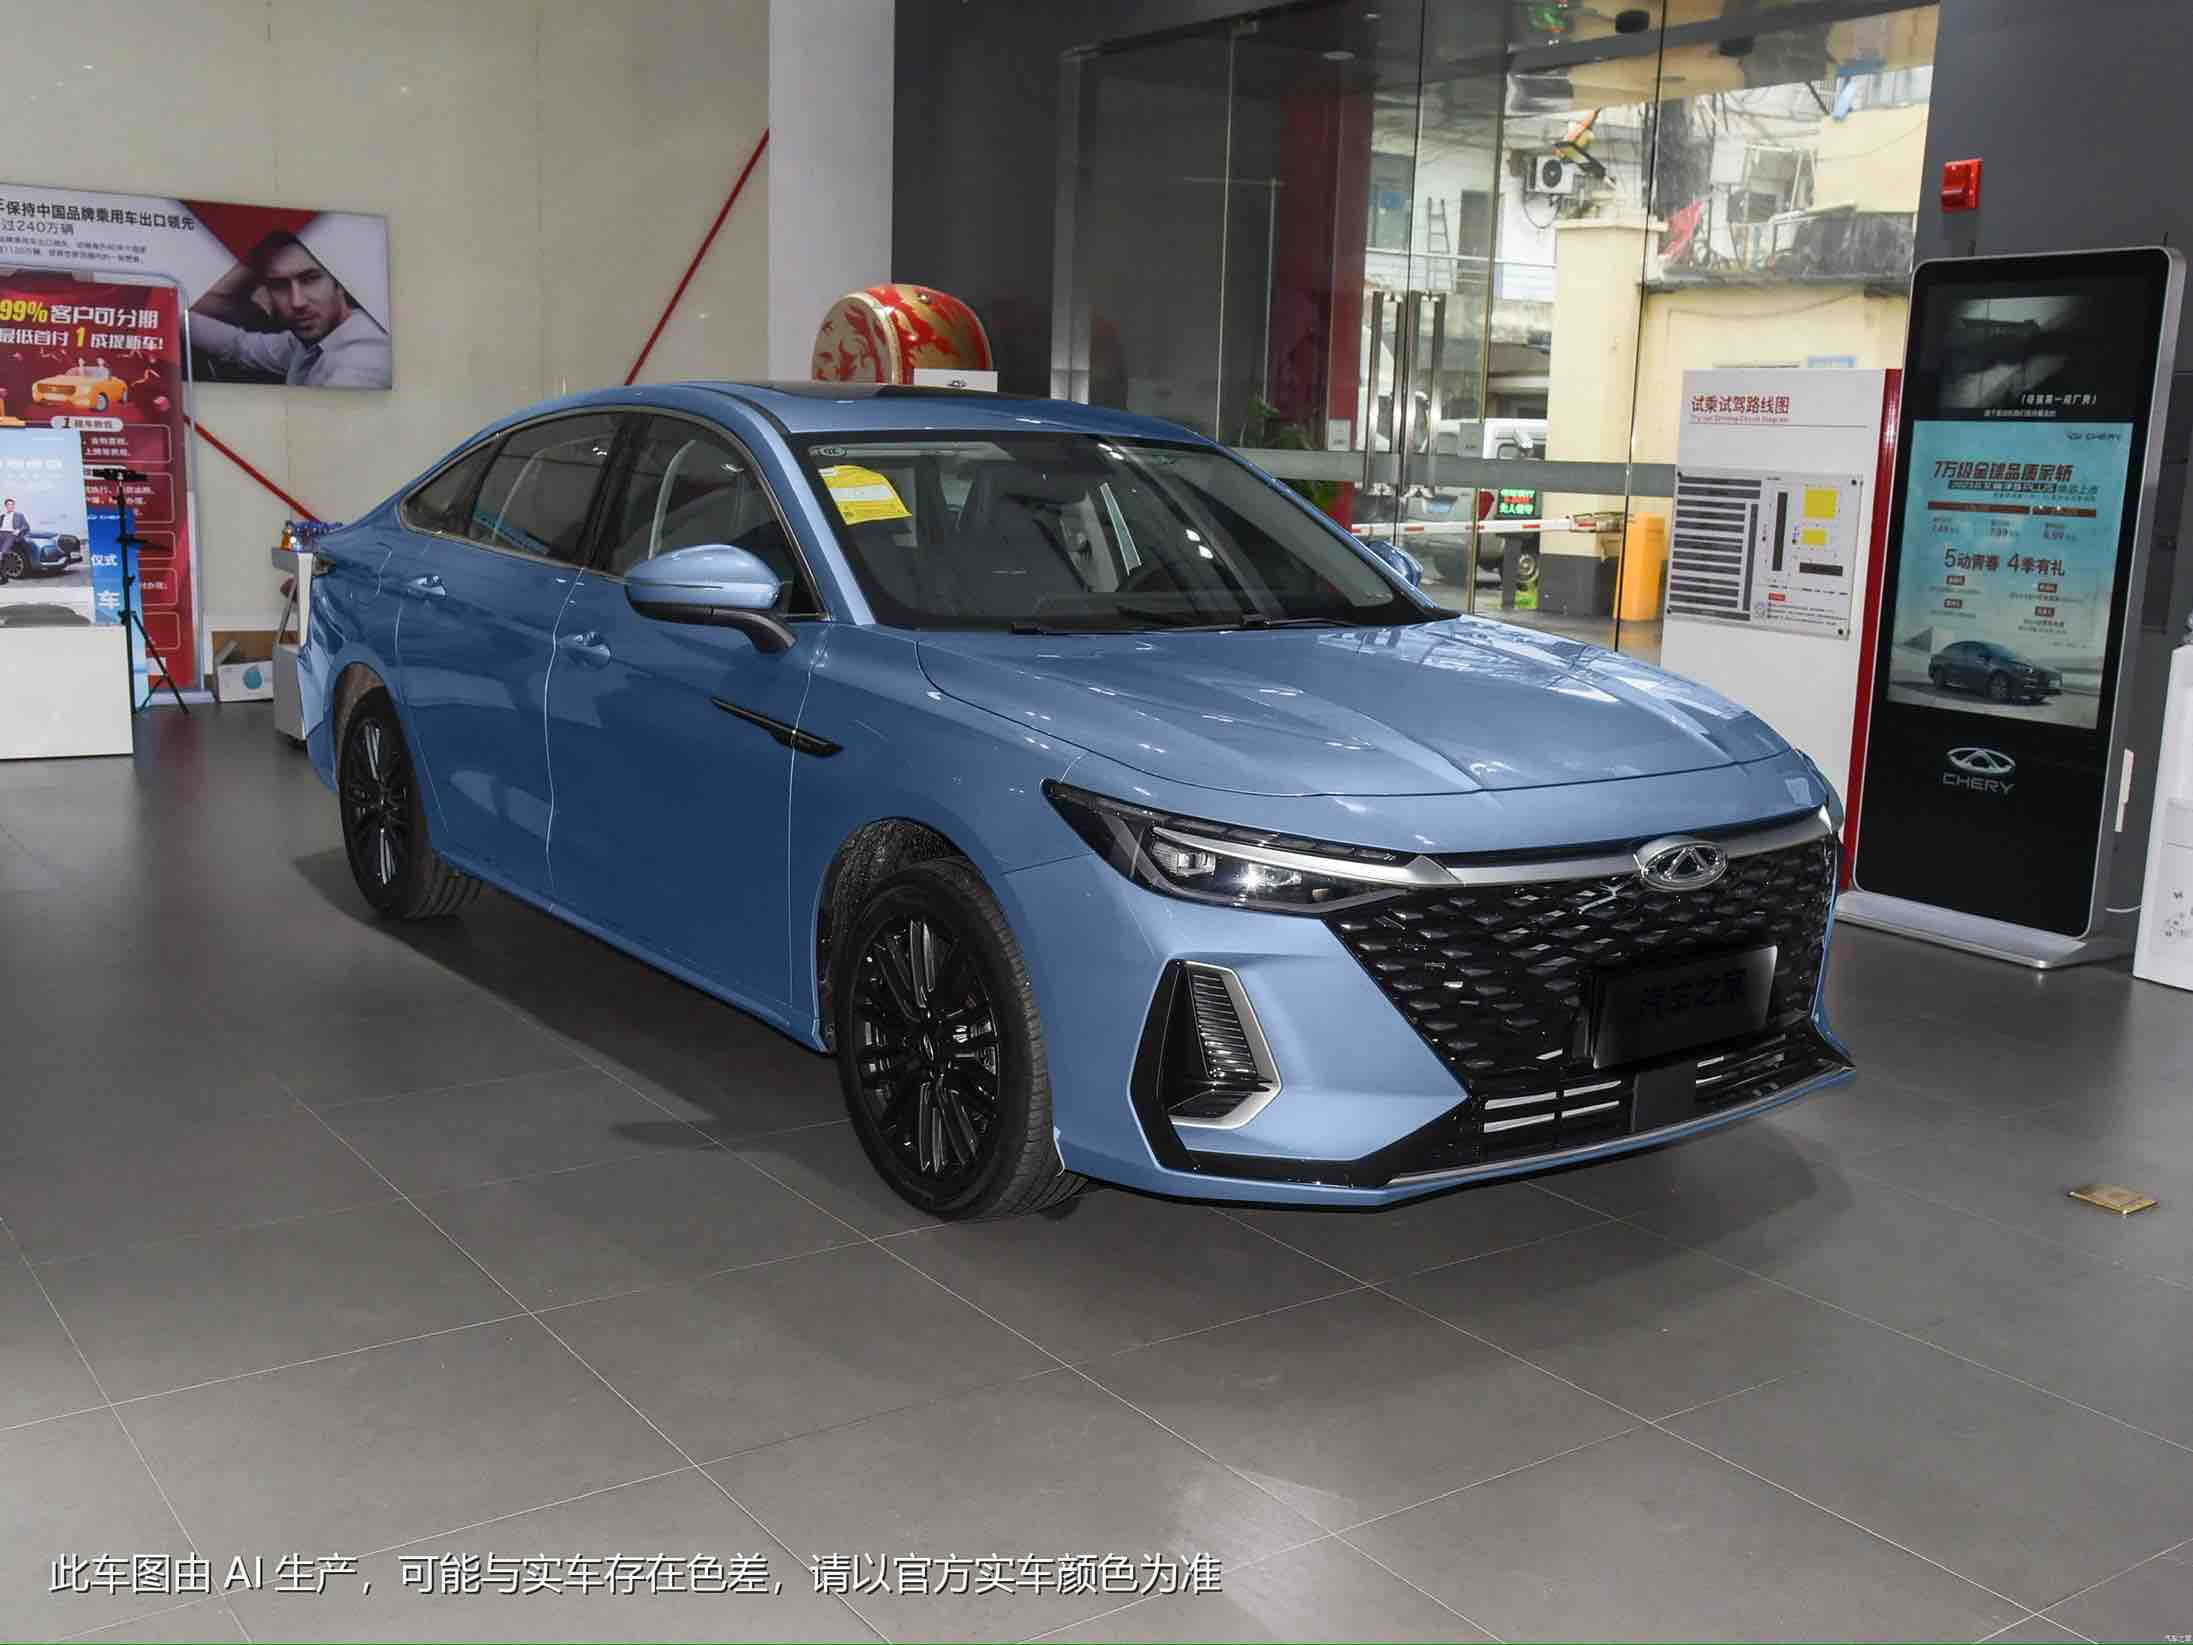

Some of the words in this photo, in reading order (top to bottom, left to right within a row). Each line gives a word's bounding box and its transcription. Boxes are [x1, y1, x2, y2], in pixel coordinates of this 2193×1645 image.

[1690, 395, 1790, 414] 试乘试驾路线图
[1942, 773, 2015, 795] CHERY
